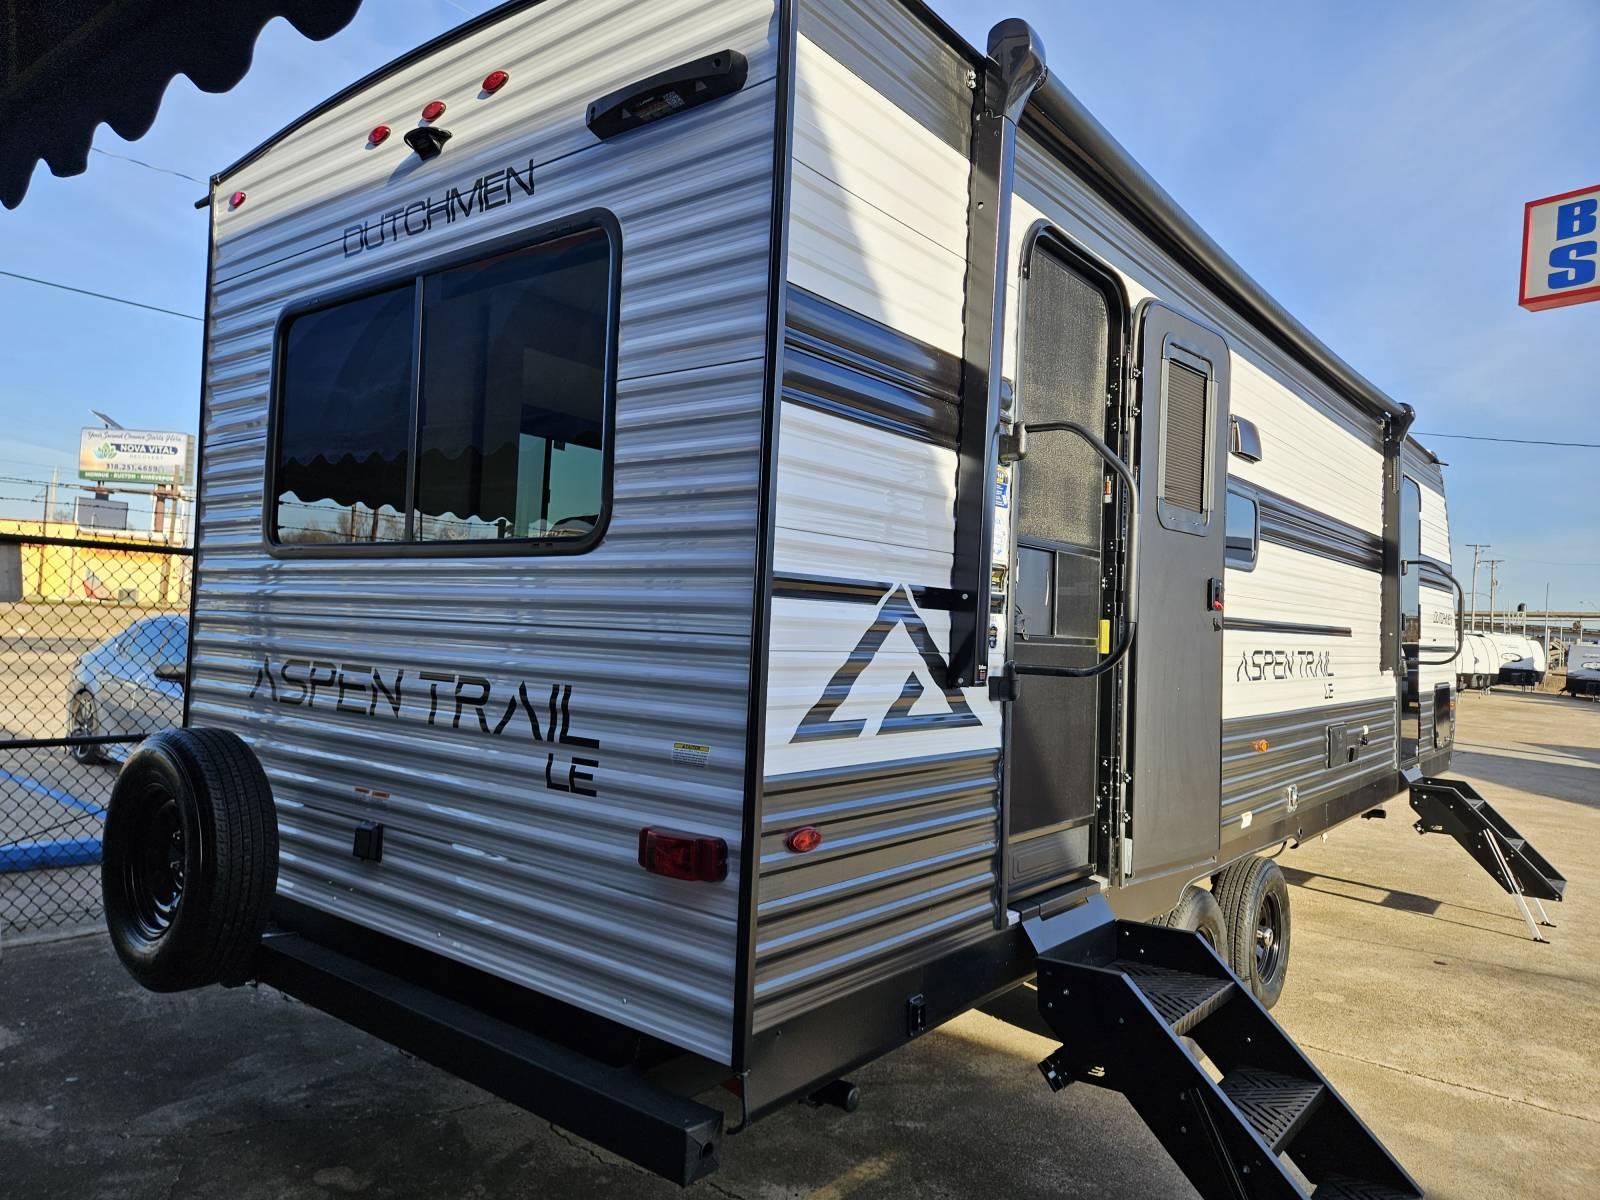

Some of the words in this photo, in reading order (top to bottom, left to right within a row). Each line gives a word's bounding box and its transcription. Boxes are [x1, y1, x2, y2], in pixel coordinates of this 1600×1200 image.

[343, 159, 535, 258] DUTCHMEN
[1556, 198, 1598, 241] B
[1548, 240, 1598, 290] S
[120, 444, 146, 453] NOVA
[148, 445, 176, 455] VITAL
[1236, 650, 1294, 682] ASPEN
[1298, 650, 1334, 678] TRAIL
[250, 656, 404, 720] ASPEN
[419, 671, 600, 749] TRAIL
[1323, 682, 1334, 699] LE
[546, 753, 599, 797] LE
